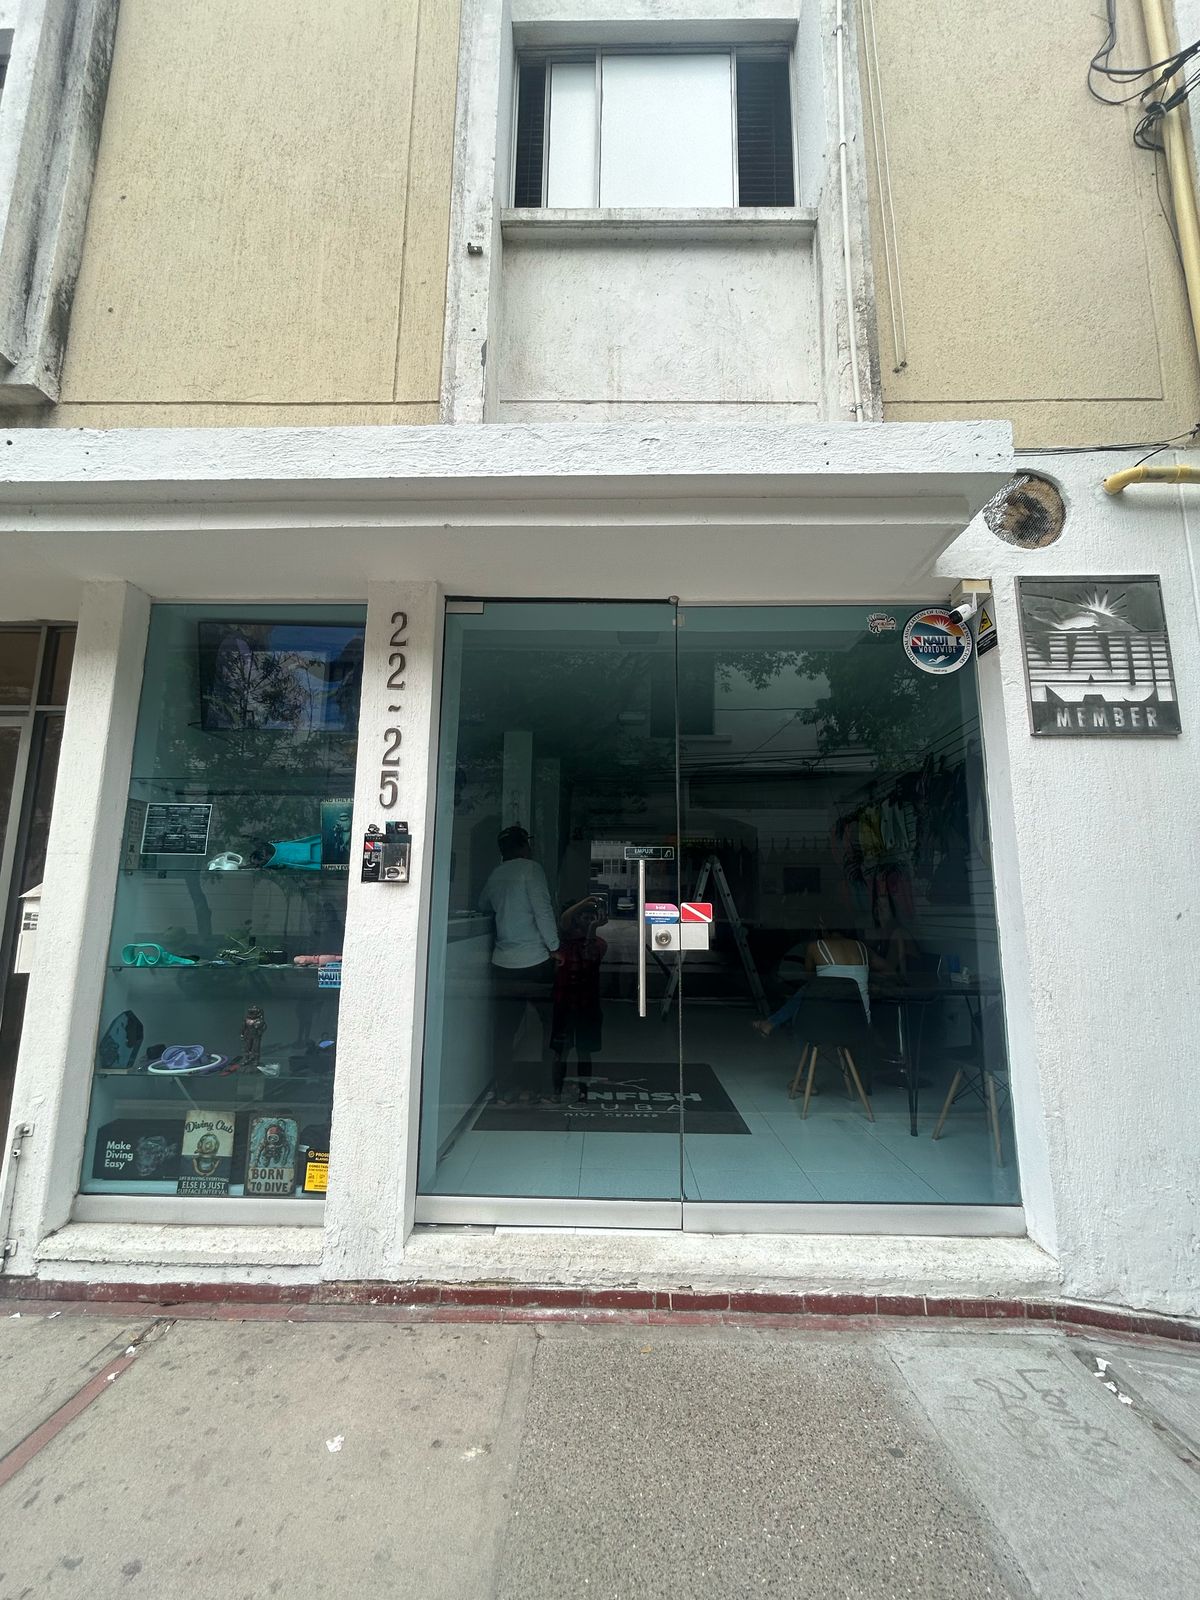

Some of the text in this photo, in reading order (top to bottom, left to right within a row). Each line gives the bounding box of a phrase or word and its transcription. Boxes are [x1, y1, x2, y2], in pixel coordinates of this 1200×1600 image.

[923, 636, 949, 647] NAUI
[1056, 706, 1159, 728] MEMBER
[185, 1119, 234, 1134] Diving Club
[106, 1140, 132, 1150] Make
[105, 1150, 134, 1162] Diving
[104, 1159, 125, 1170] Easy
[251, 1168, 284, 1180] BORN
[181, 1181, 226, 1190] ELSE IS JUST
[251, 1182, 289, 1193] TO DIVE
